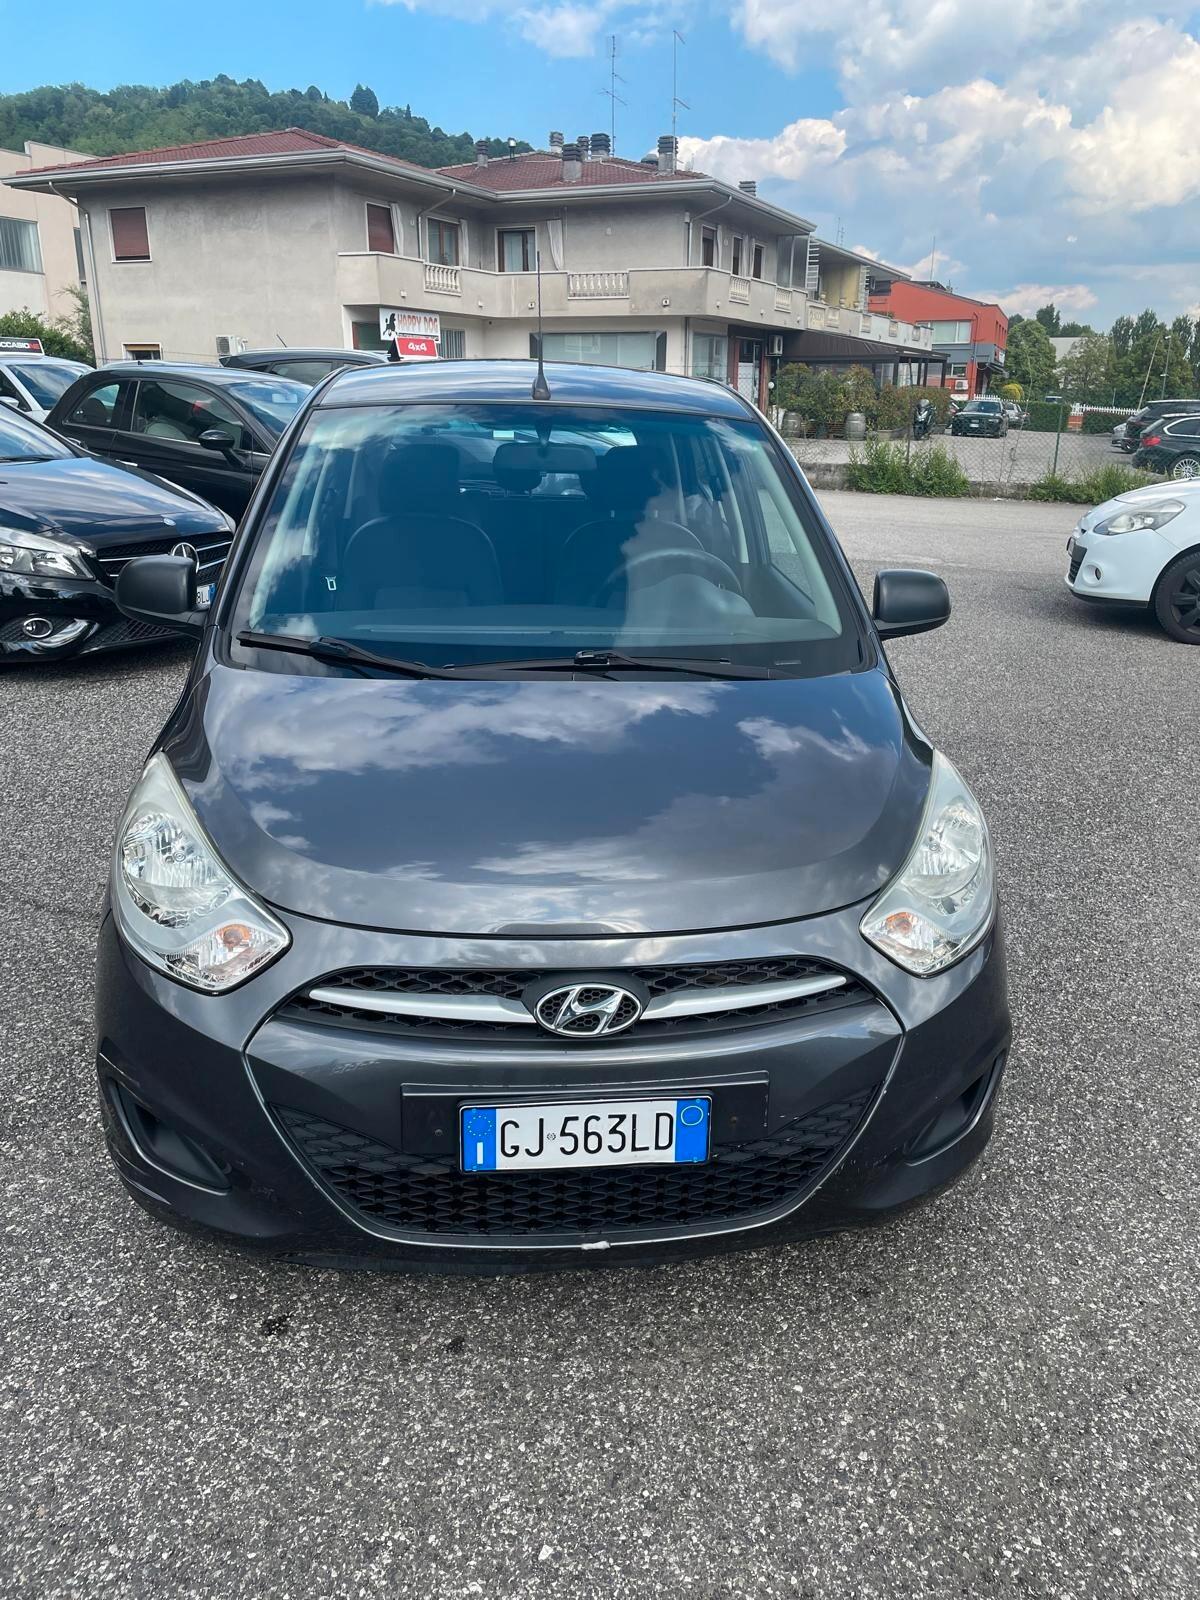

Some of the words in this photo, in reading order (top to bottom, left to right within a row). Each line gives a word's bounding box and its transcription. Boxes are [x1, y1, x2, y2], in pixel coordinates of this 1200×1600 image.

[397, 313, 421, 330] HAPPY
[423, 316, 439, 332] DOG
[408, 342, 427, 352] 4x4
